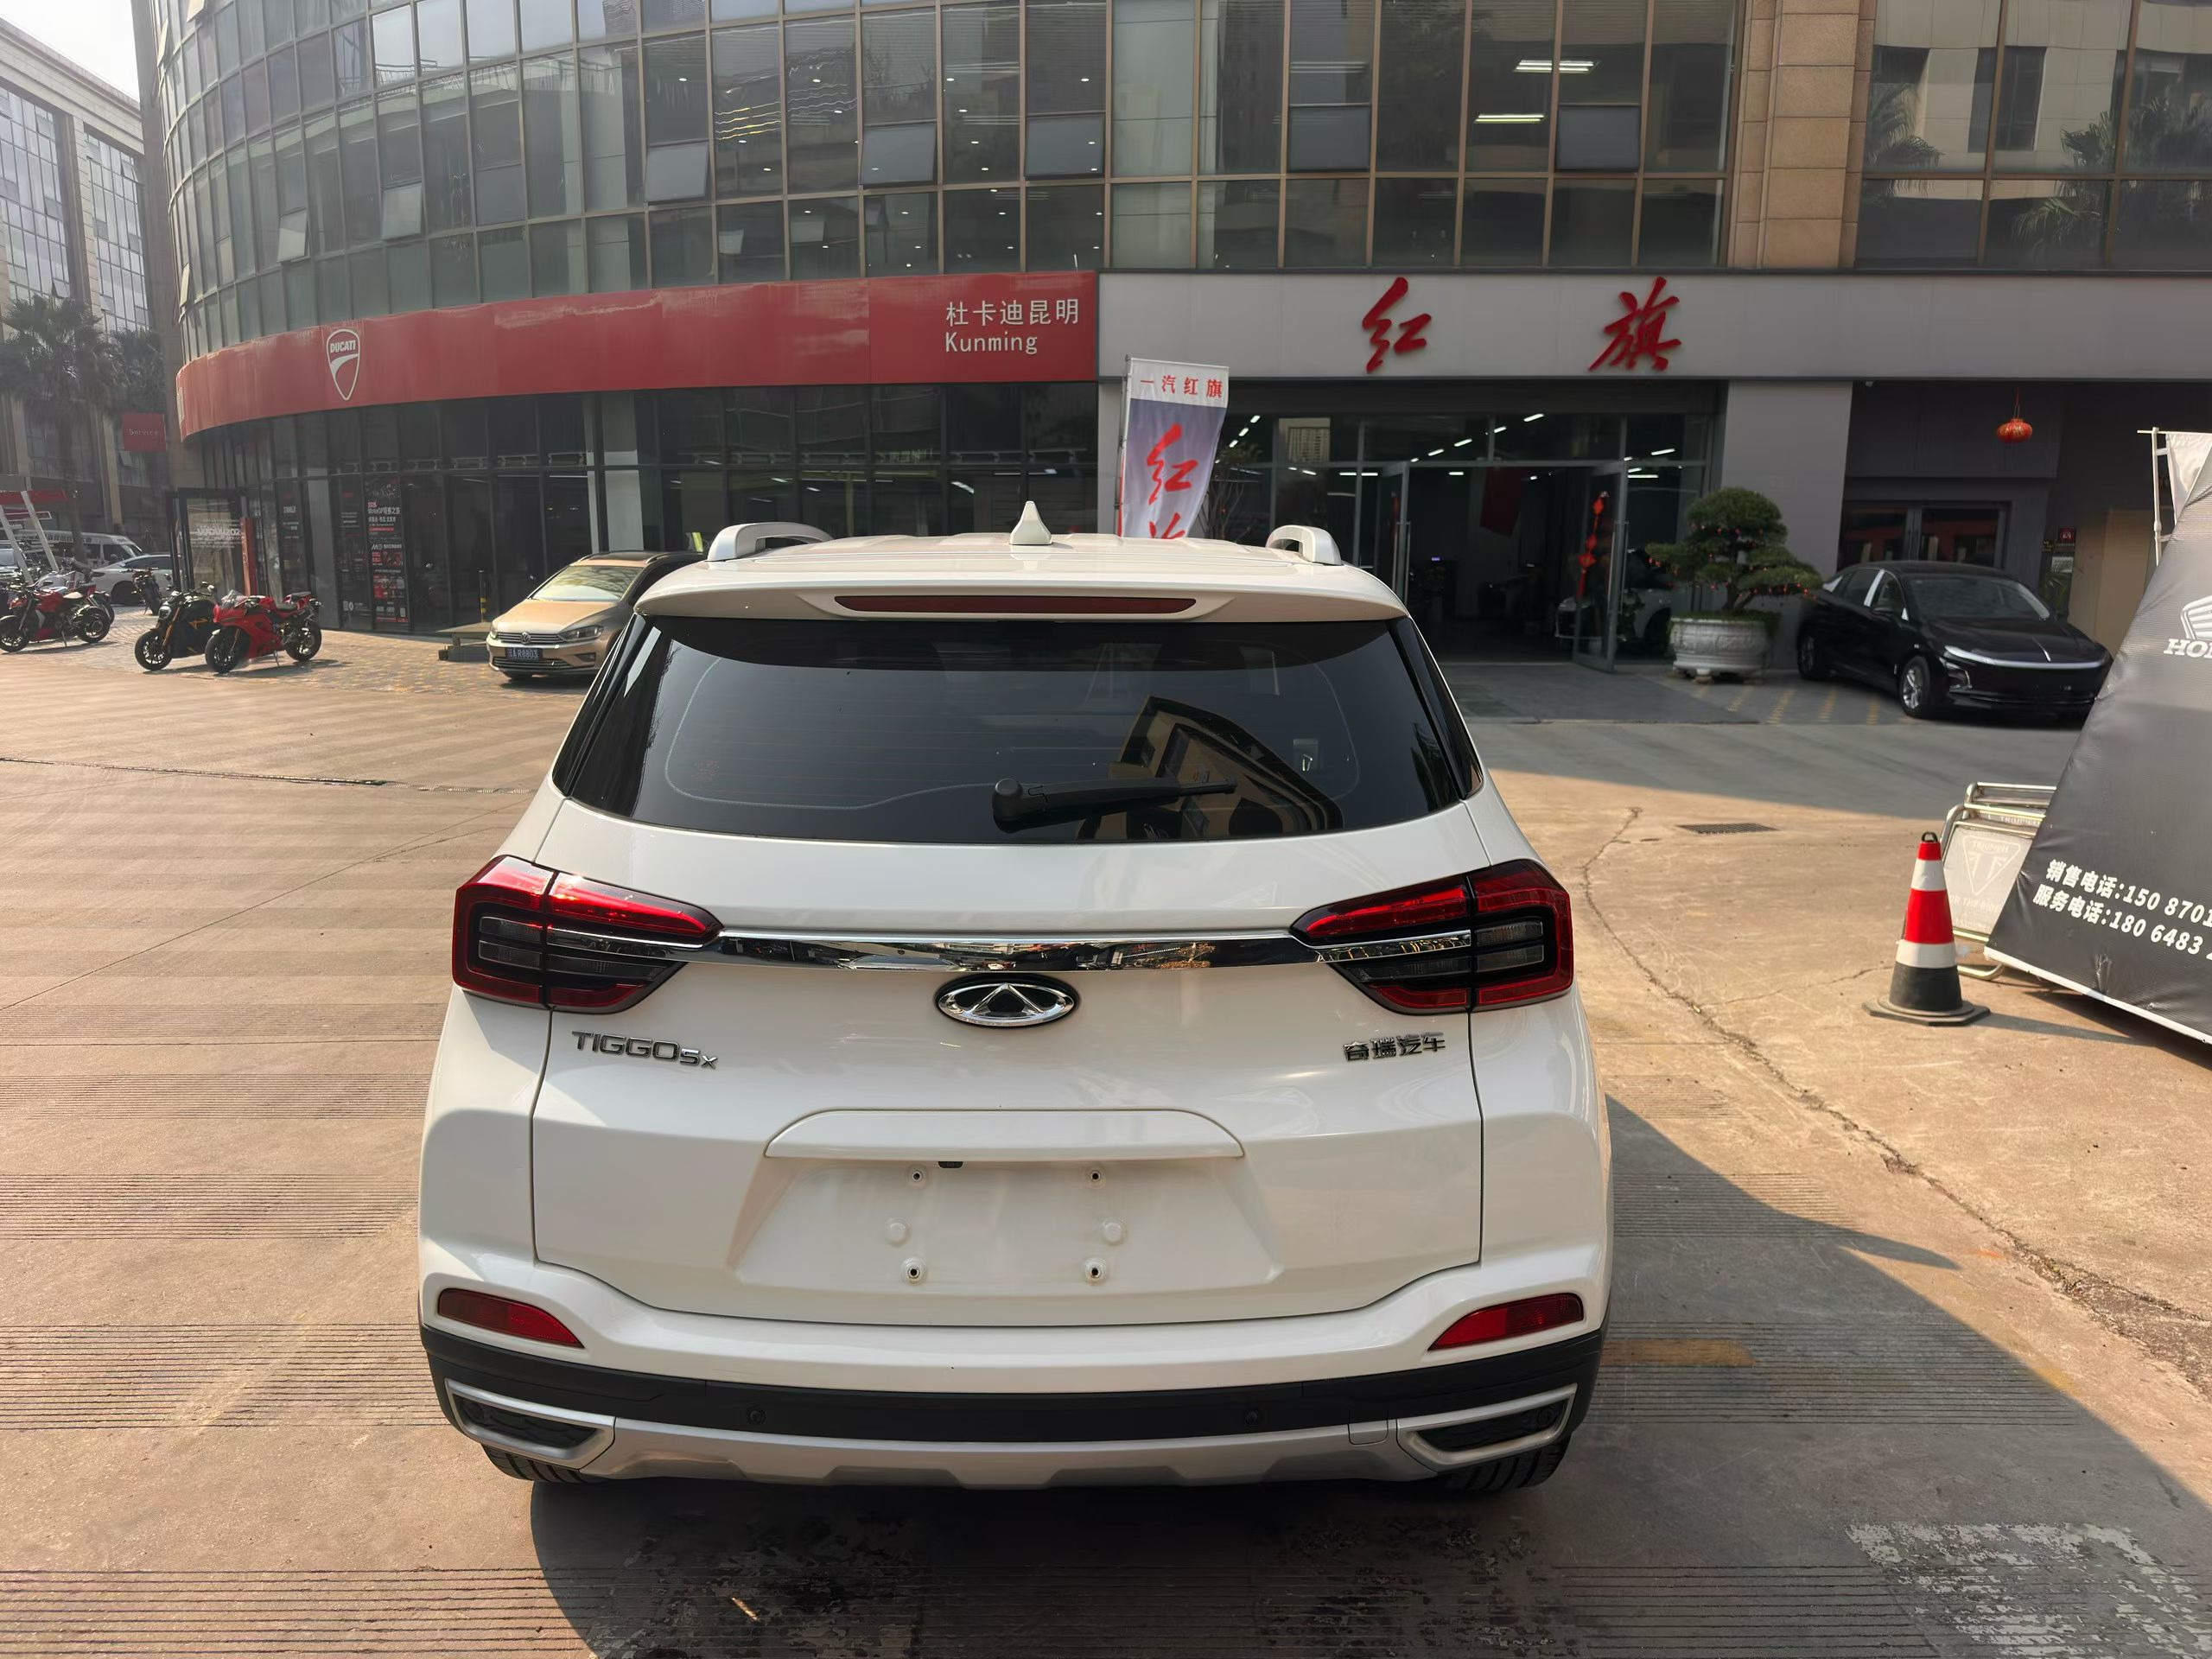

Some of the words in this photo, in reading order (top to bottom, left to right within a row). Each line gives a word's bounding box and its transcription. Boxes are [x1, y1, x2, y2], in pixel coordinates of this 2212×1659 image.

[945, 298, 1079, 327] 杜卡迪昆明
[1362, 276, 1681, 374] 红旗
[330, 340, 356, 353] DUCATI
[945, 331, 1038, 355] Kunming
[1140, 375, 1223, 398] 一汽红旗
[1971, 840, 2009, 854] TRIUMPH
[2032, 883, 2146, 938] 服务电话:180
[2150, 925, 2203, 955] 6483
[1343, 1032, 1446, 1062] 奇瑞汽车
